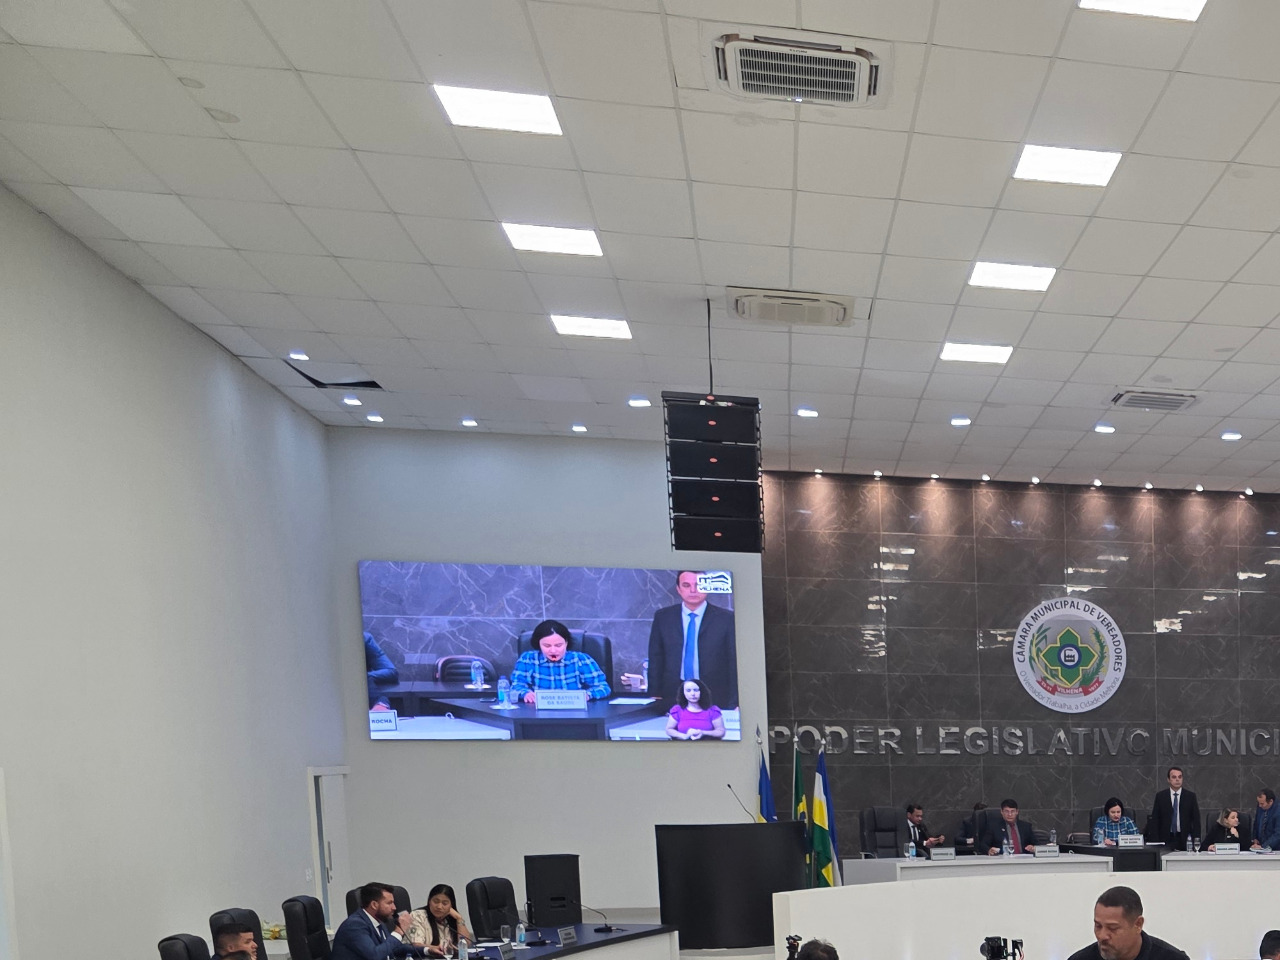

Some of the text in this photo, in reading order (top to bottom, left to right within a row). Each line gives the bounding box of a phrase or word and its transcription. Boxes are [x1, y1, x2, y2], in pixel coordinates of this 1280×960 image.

[1017, 600, 1123, 673] CÂMARA MUNICIPAL DE VEREADORES
[1020, 670, 1027, 678] O
[1023, 675, 1046, 701] Vereador
[1057, 685, 1083, 694] VILHENA
[1080, 696, 1101, 709] Cidade
[769, 725, 904, 755] PODER
[916, 726, 1150, 756] LEGISLATIVO
